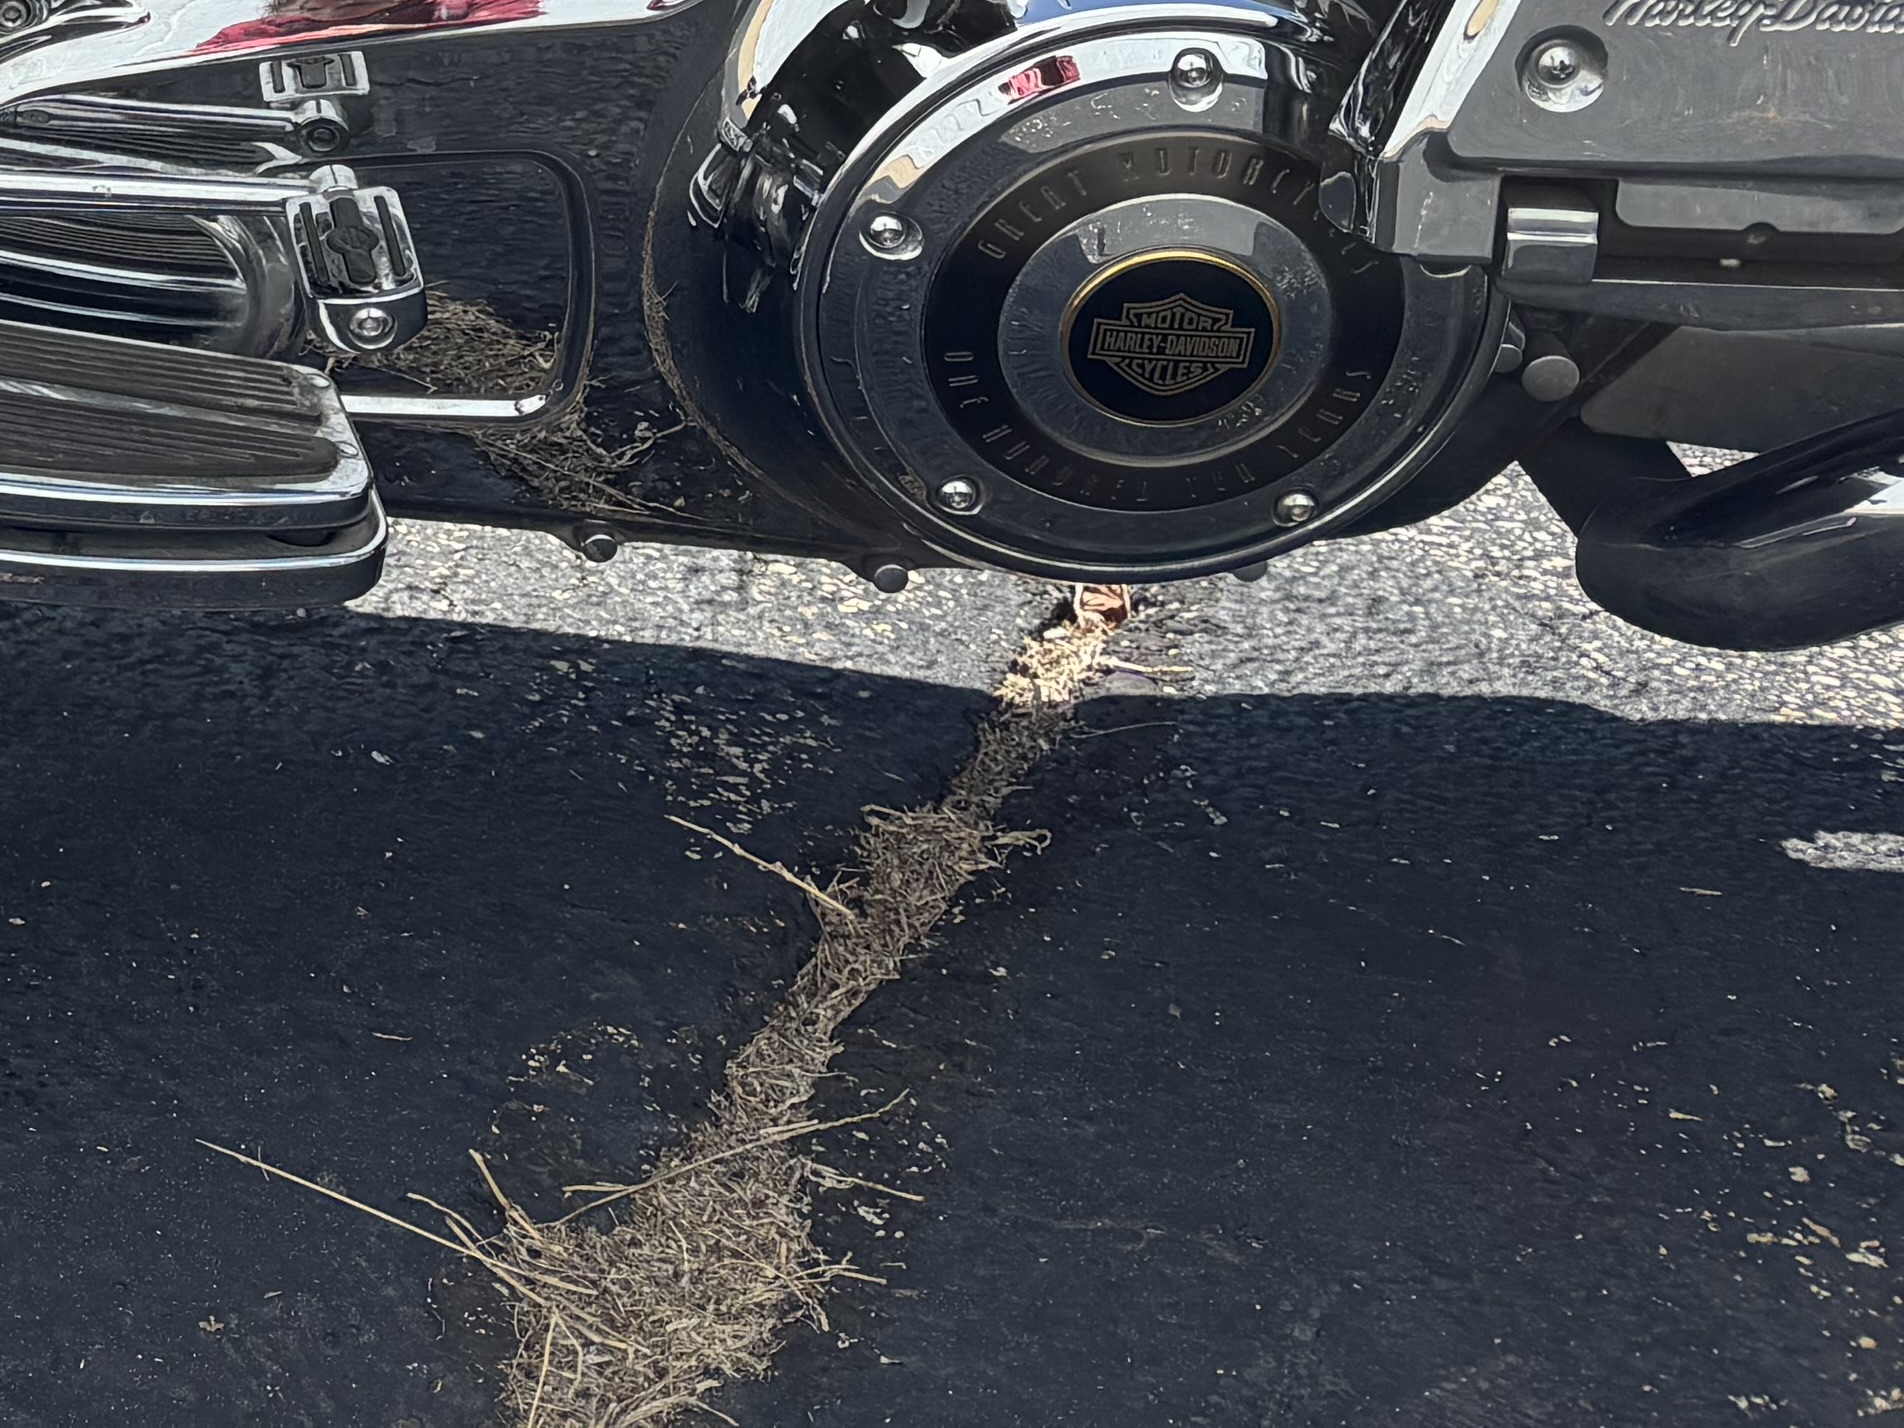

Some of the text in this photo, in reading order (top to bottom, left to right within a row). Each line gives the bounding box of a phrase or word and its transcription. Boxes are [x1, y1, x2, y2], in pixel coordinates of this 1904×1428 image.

[978, 168, 1089, 261] GREAT
[1141, 308, 1214, 330] MOTOR
[1103, 331, 1240, 358] HARLEY-DAVIDSON
[1131, 358, 1204, 381] CYCLES
